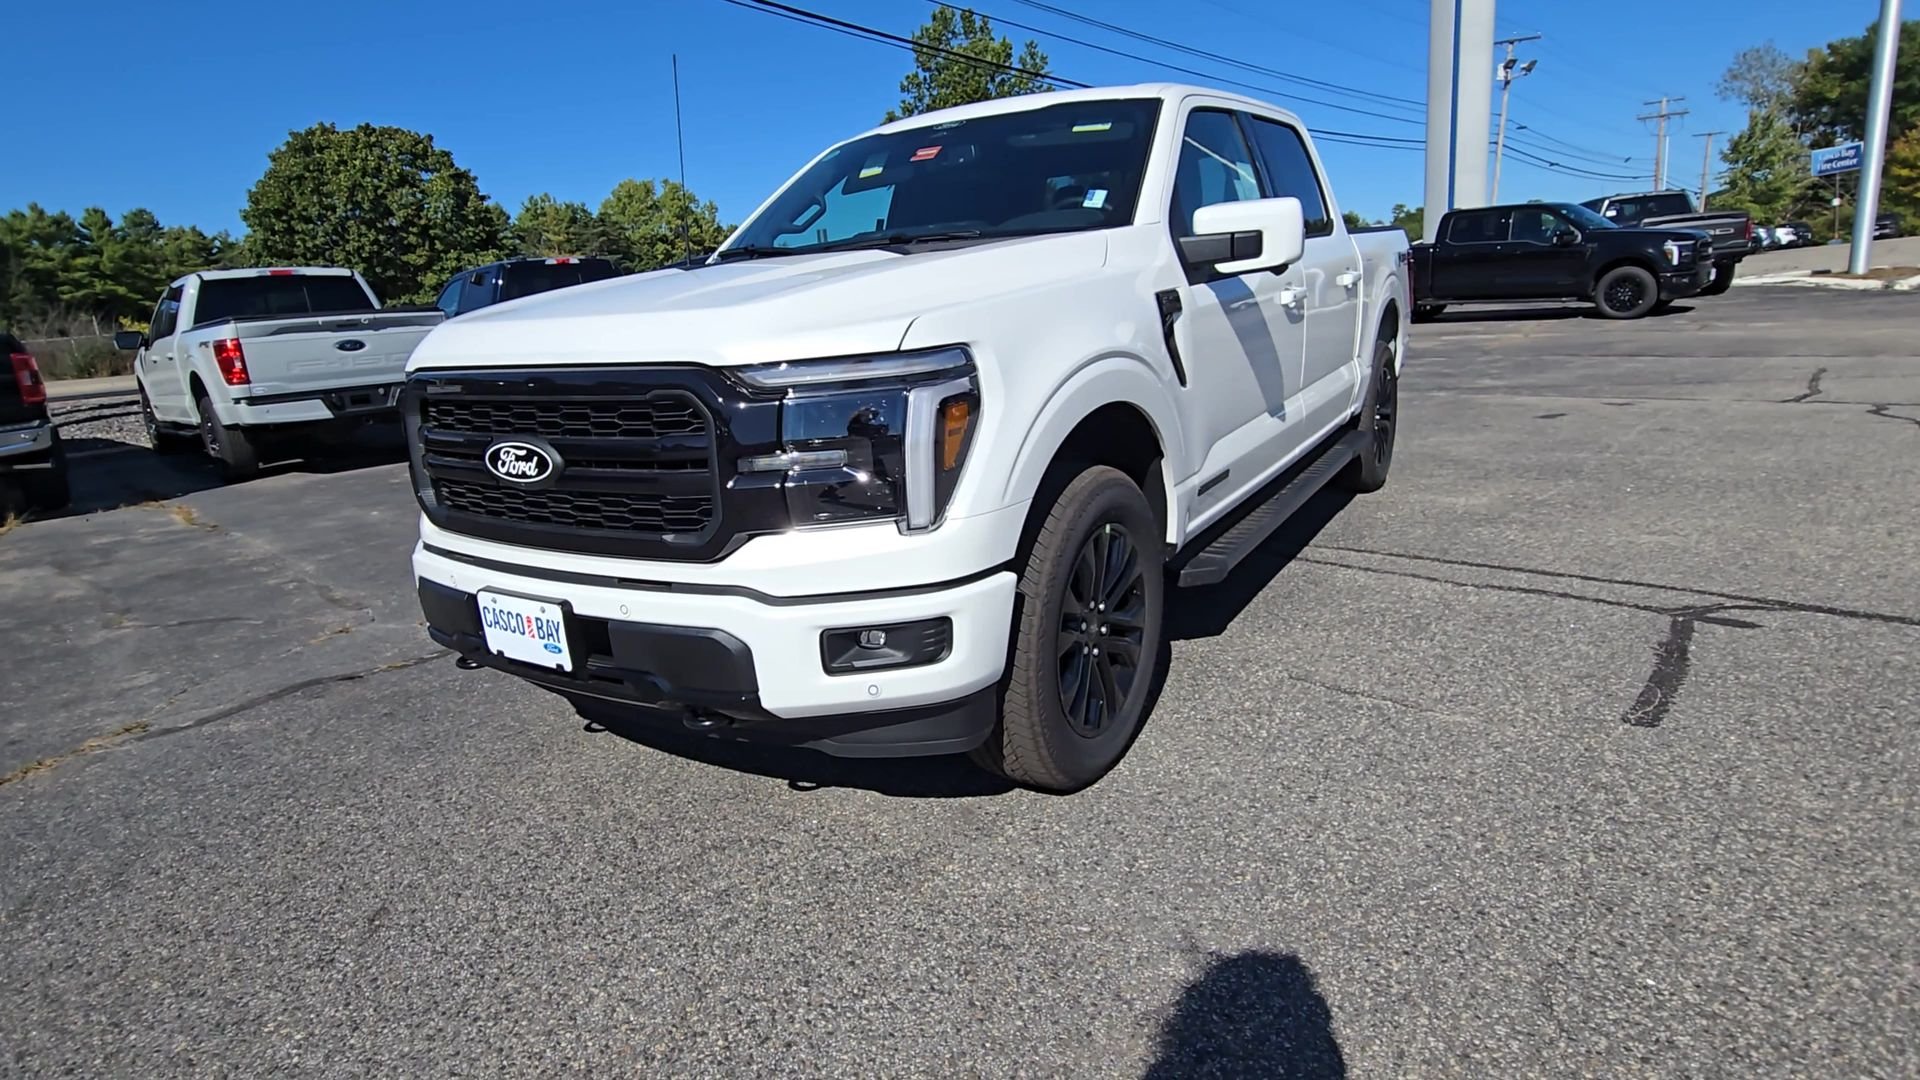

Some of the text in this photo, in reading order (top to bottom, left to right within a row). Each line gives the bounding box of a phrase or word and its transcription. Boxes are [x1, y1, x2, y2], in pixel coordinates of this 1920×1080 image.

[1841, 148, 1856, 158] Bay
[1832, 158, 1858, 168] Center
[498, 447, 539, 476] Ford
[482, 605, 561, 643] CASCO BAY
